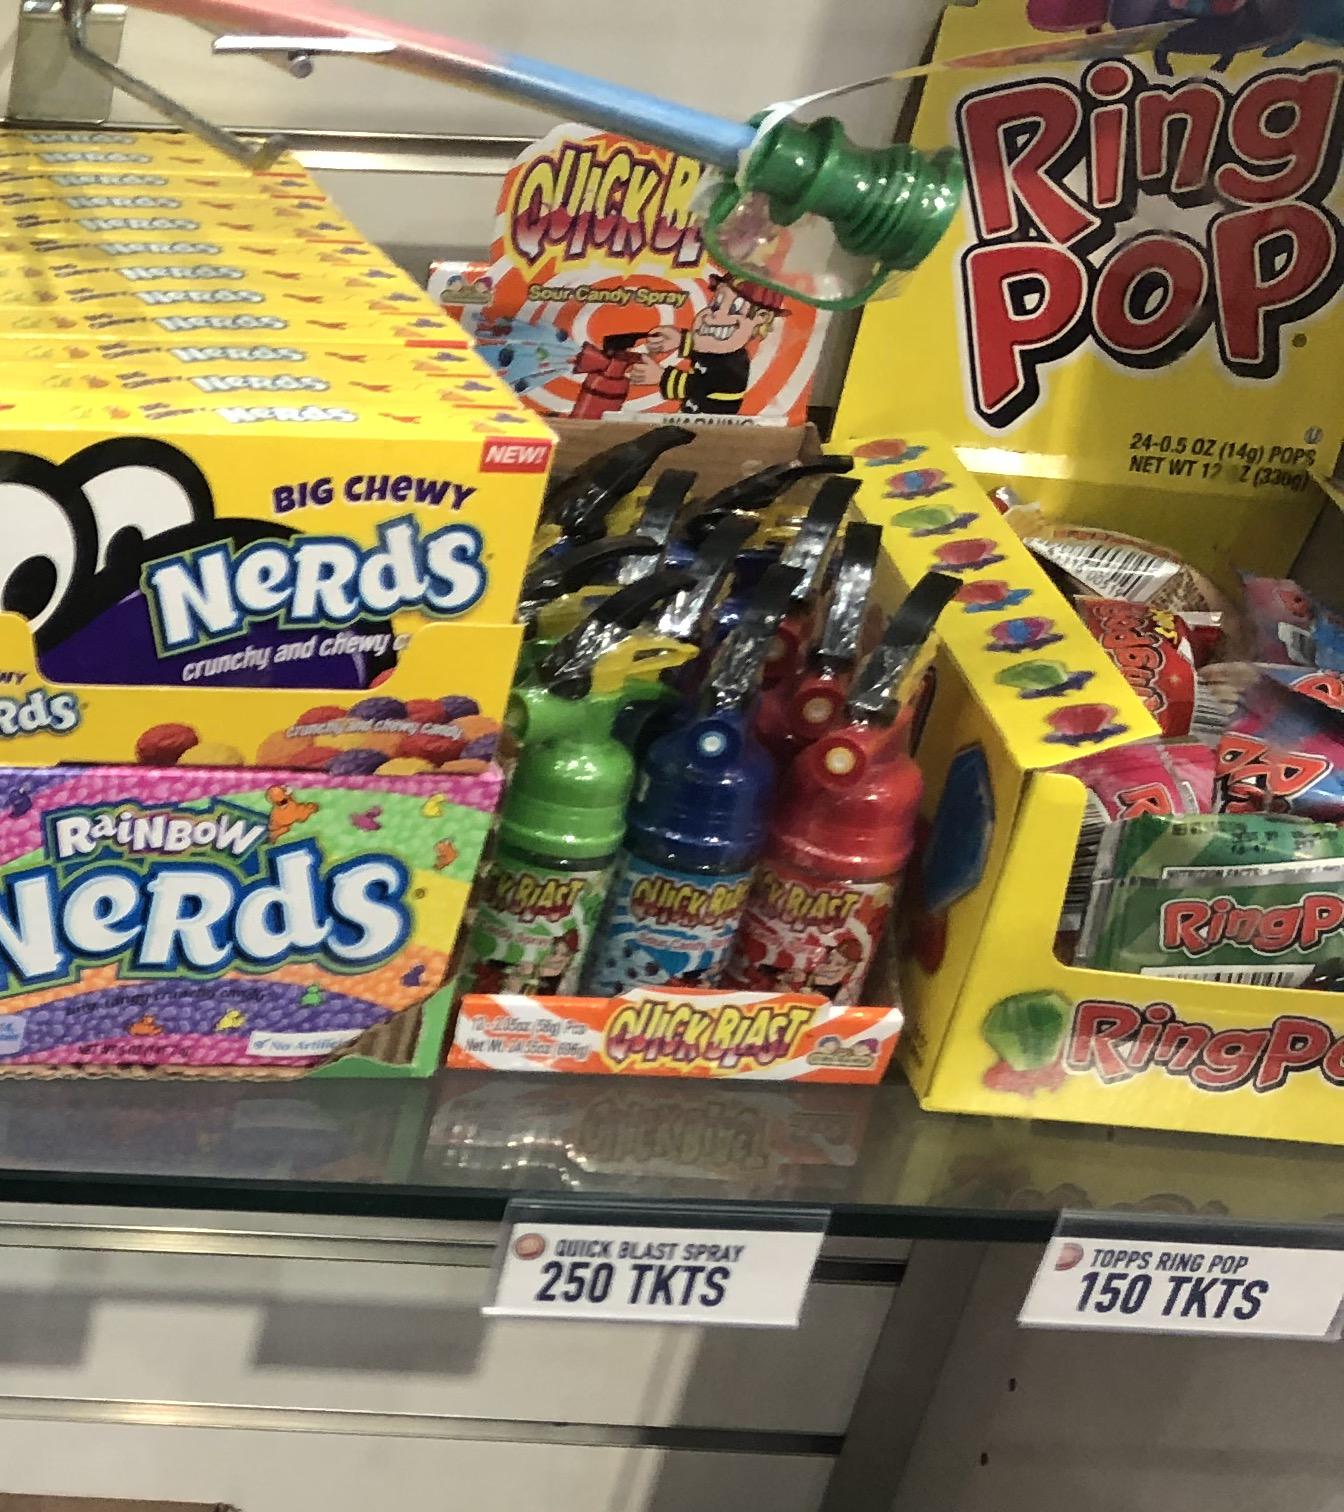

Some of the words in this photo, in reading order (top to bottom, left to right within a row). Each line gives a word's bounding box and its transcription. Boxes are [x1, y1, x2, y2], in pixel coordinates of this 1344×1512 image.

[958, 57, 1344, 250] Ring
[512, 143, 661, 265] QUICK
[484, 444, 545, 466] NEW!
[273, 476, 334, 513] BIG
[607, 1000, 713, 1069] QUICK
[708, 1003, 815, 1070] BLAST
[554, 1239, 615, 1259] QUICK
[617, 1240, 676, 1261] BLAST
[682, 1243, 745, 1263] SPRAY
[1090, 1249, 1153, 1270] TOPPS
[1155, 1251, 1206, 1273] RING
[1208, 1255, 1249, 1275] POP
[534, 1261, 615, 1303] 250
[627, 1263, 730, 1307] TKTS
[1076, 1271, 1152, 1314] 150
[1161, 1275, 1269, 1320] TKTS
